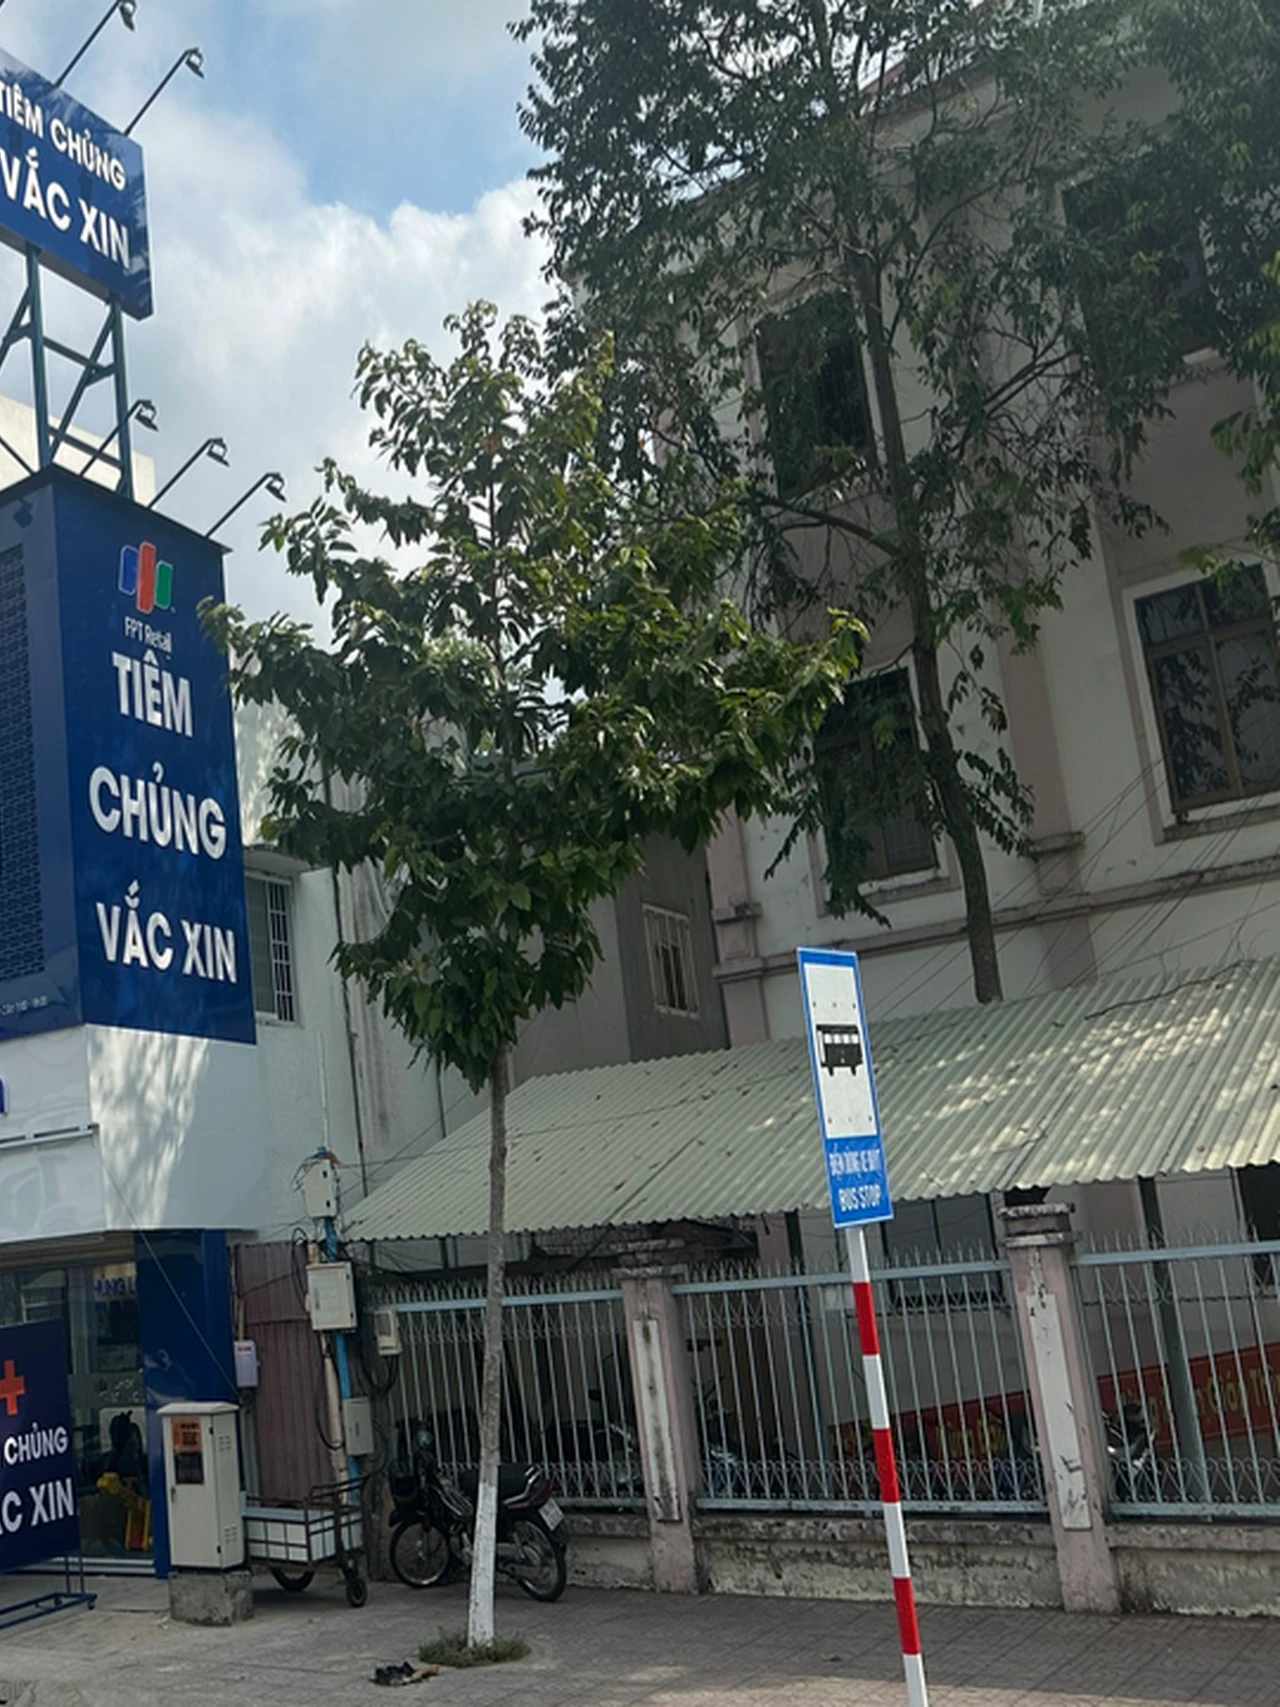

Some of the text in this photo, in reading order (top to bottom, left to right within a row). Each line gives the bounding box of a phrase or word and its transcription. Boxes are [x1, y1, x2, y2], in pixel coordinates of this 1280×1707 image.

[49, 117, 127, 192] CHỦNG
[78, 197, 131, 270] XIN
[124, 614, 173, 654] FPT Retail
[112, 650, 194, 739] TIÊM
[89, 762, 227, 860] CHỦNG
[96, 879, 238, 984] VẮC XIN
[839, 1183, 881, 1213] BUS STOP
[4, 1422, 69, 1466] CHỦNG
[29, 1477, 74, 1527] XIN
